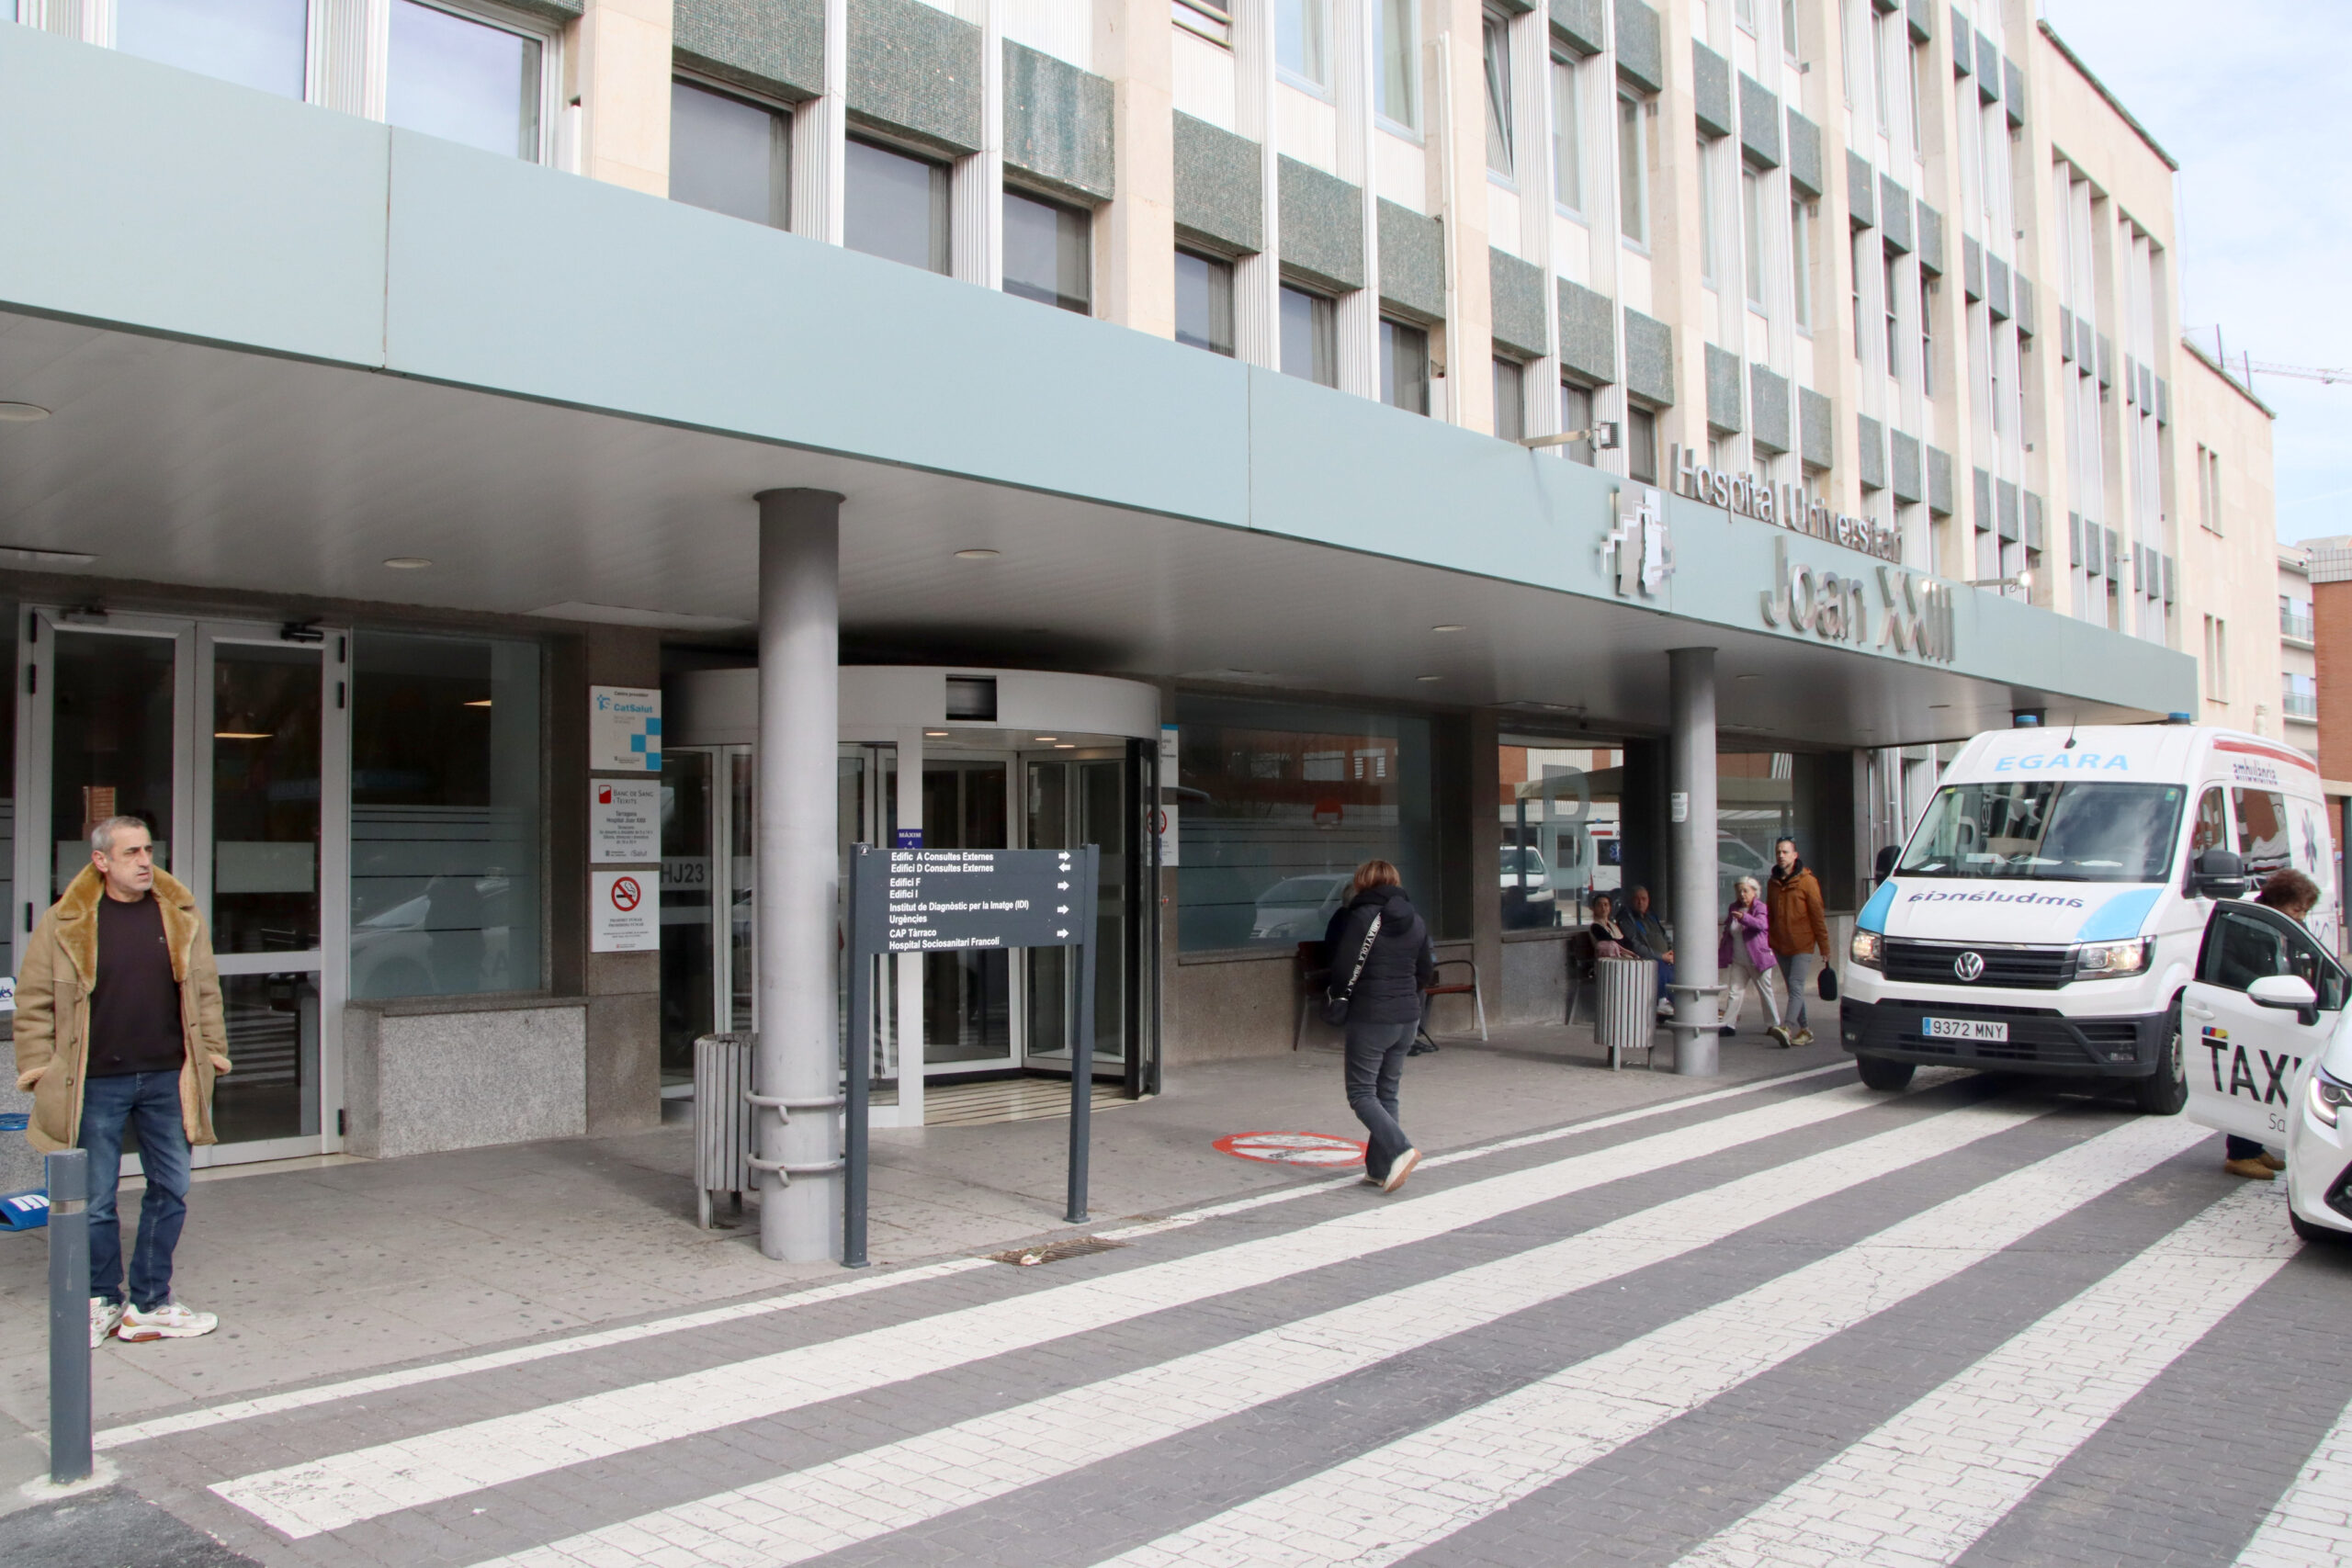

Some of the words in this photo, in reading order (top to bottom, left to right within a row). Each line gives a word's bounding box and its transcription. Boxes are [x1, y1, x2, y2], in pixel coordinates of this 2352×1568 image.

[1670, 443, 1786, 527] Hospital
[1783, 483, 1903, 564] Universitari
[1759, 535, 1867, 645] Joan
[1876, 565, 1955, 665] XXIII
[614, 703, 653, 714] CatSalut
[1994, 753, 2130, 772] EGARA
[891, 852, 913, 861] Edific
[917, 852, 923, 861] A
[924, 852, 961, 861] Consultes
[963, 852, 993, 861] Externes
[661, 863, 705, 884] HJ23
[891, 863, 915, 873] Edifici
[917, 863, 922, 873] D
[924, 863, 961, 873] Consultes
[963, 863, 994, 873] Externes
[889, 877, 914, 887] Edifici
[916, 877, 921, 886] F
[889, 889, 914, 899] Edifici
[889, 902, 916, 912] Institut
[918, 902, 927, 911] de
[929, 901, 967, 913] Diagnòstic
[969, 902, 981, 912] per
[982, 901, 989, 909] la
[990, 900, 1013, 912] Imatge
[1014, 900, 1029, 910] (IDI)
[889, 914, 928, 925] Urgències
[889, 929, 907, 938] CAP
[908, 928, 937, 938] Tàrraco
[889, 940, 921, 952] Hospital
[922, 938, 969, 949] Sociosanitari
[971, 937, 1000, 947] Francolí
[1933, 1021, 1970, 1036] 9372
[1975, 1022, 2004, 1039] MNY
[2201, 1037, 2302, 1110] TAX
[2268, 1112, 2287, 1133] Sa
